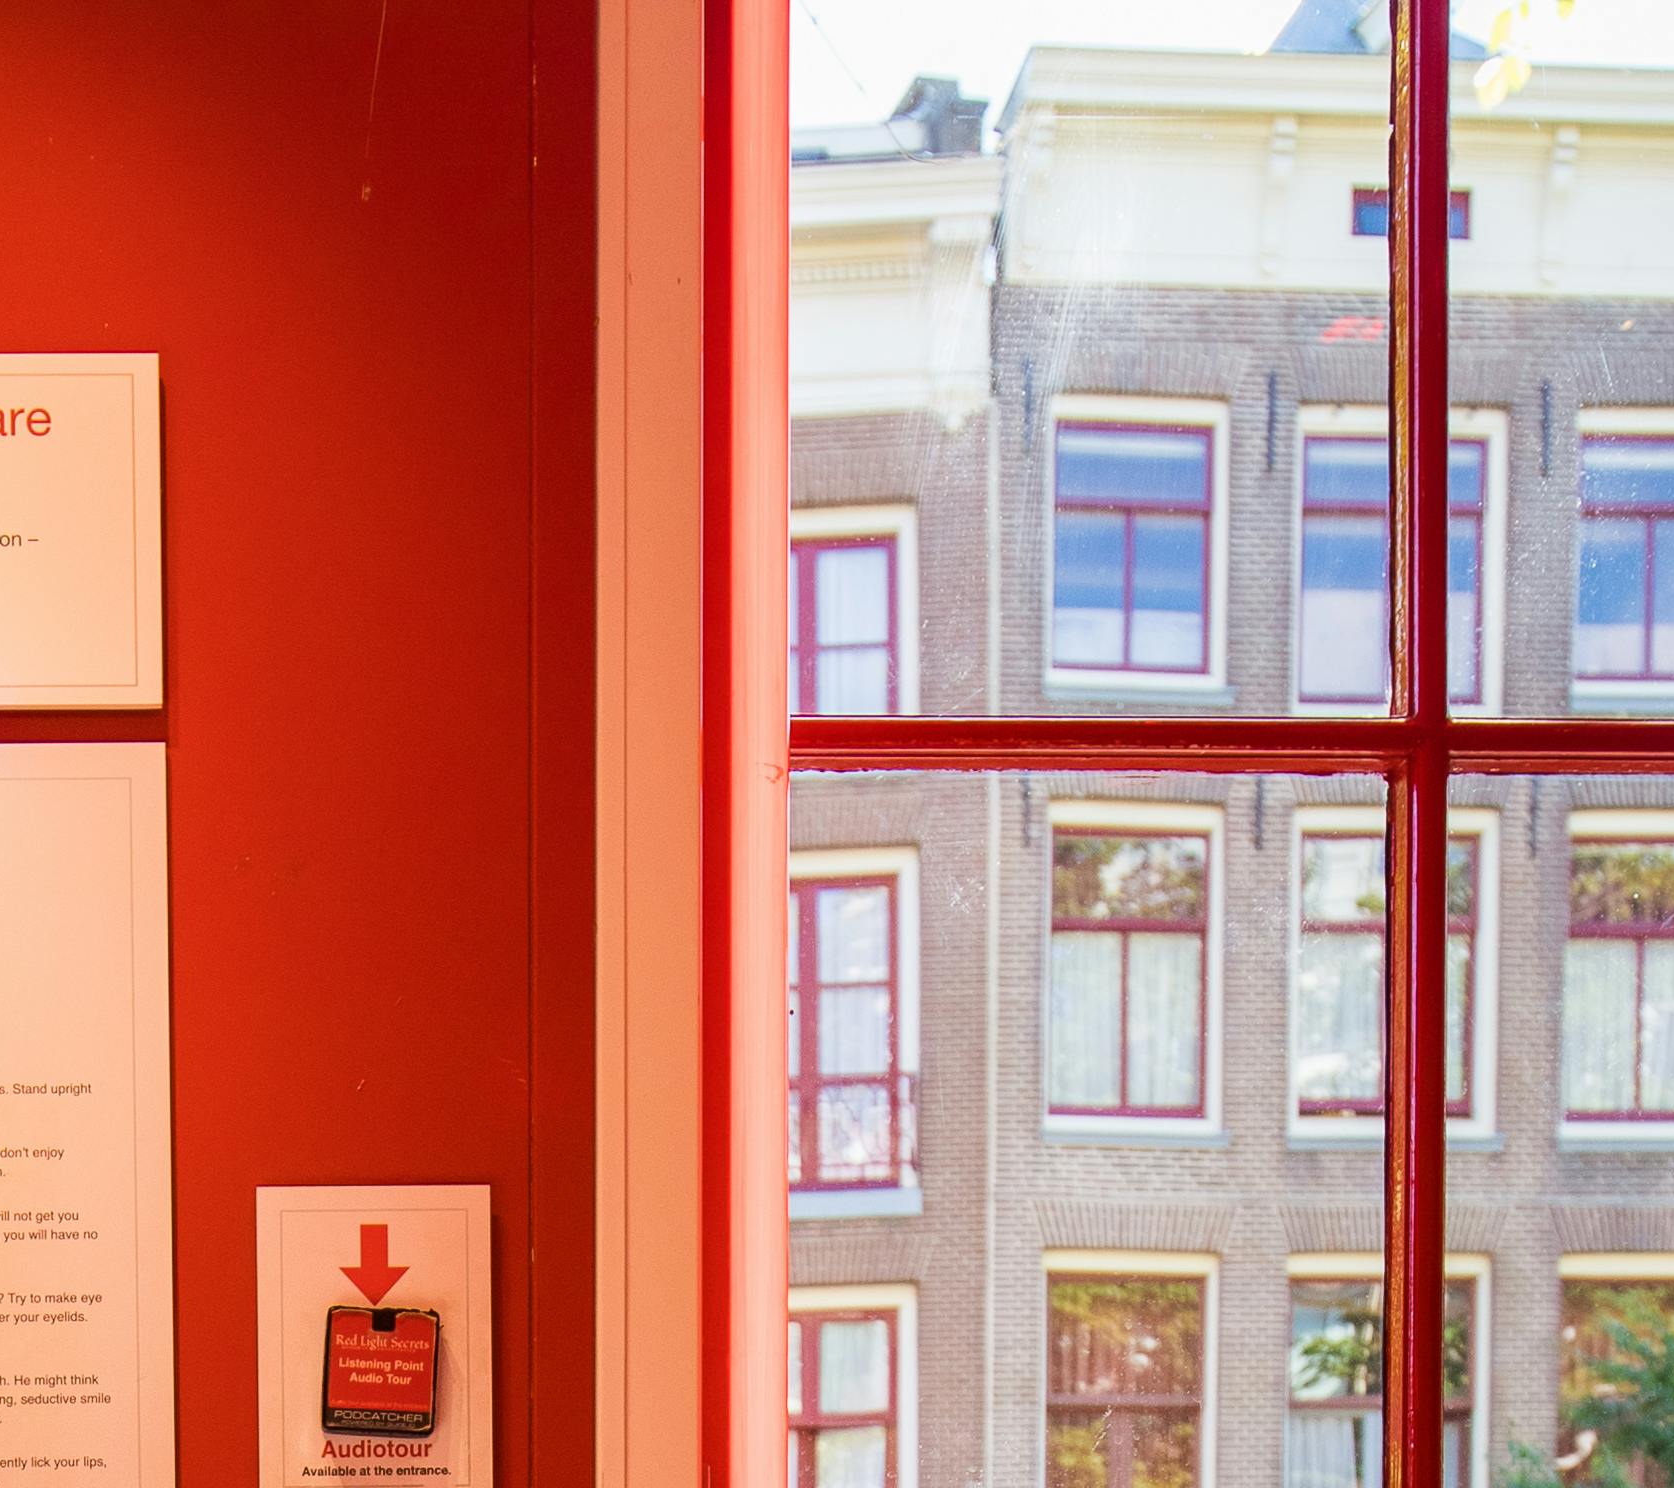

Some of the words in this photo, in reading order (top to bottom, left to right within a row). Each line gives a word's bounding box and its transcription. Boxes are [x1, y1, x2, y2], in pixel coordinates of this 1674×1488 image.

[12, 1082, 48, 1095] Stand
[50, 1082, 92, 1097] upright
[32, 1147, 65, 1161] enjoy
[336, 1334, 358, 1345] Red
[360, 1335, 387, 1350] Light
[390, 1336, 430, 1350] Secrets
[338, 1357, 392, 1372] Listening
[394, 1359, 424, 1372] Point
[349, 1372, 384, 1384] Audio
[386, 1374, 413, 1385] Tour
[333, 1410, 423, 1423] PODCATCHER
[321, 1439, 433, 1459] Audiotour
[31, 1456, 51, 1468] lick
[53, 1458, 80, 1471] your
[83, 1455, 107, 1470] lips,
[301, 1464, 357, 1477] Available
[359, 1465, 371, 1477] at
[373, 1465, 394, 1476] the
[396, 1465, 452, 1476] entrance.
